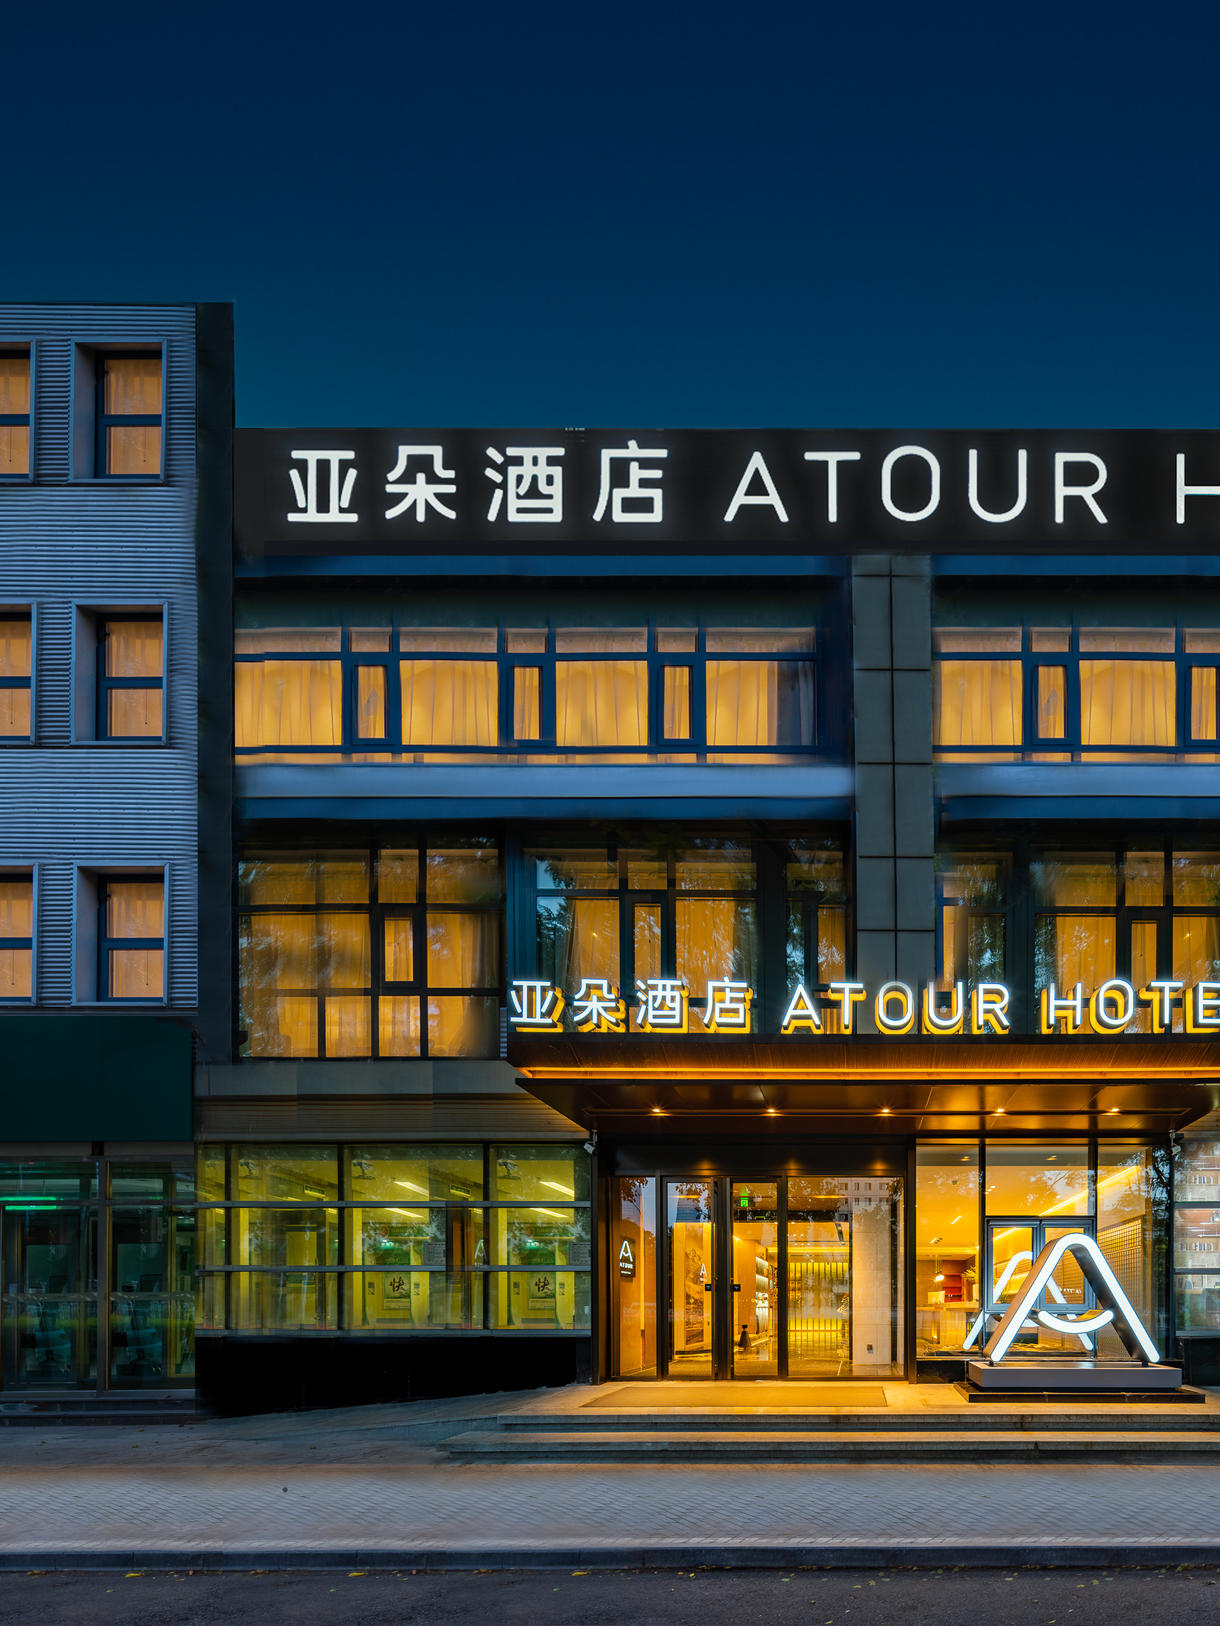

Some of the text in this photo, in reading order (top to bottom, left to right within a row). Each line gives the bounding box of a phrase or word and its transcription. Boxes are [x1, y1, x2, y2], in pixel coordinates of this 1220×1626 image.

[287, 440, 668, 523] 亚朵酒店
[723, 445, 1108, 524] ATOUR
[510, 977, 749, 1025] 亚朵酒店
[782, 980, 1011, 1027] ATOUR
